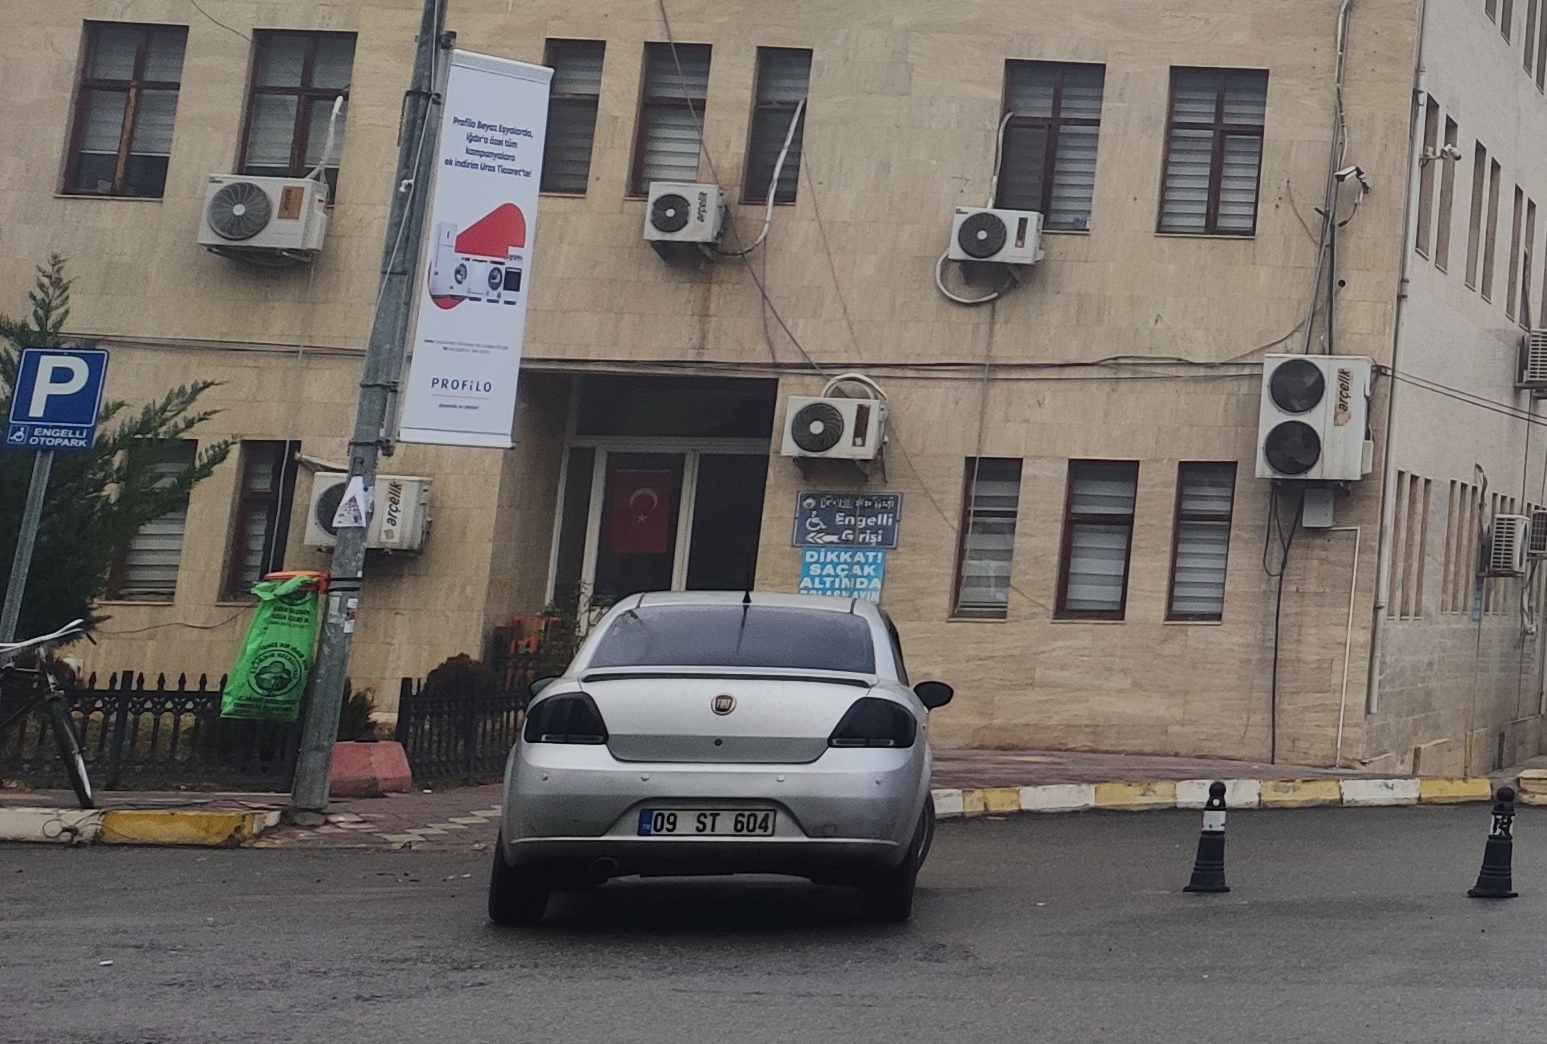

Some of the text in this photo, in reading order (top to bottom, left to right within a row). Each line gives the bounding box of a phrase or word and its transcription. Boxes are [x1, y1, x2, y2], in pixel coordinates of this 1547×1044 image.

[452, 116, 476, 128] Profilo
[477, 120, 498, 132] Beyaz
[444, 158, 453, 166] ek
[455, 157, 479, 170] indirim
[28, 355, 90, 418] P
[1337, 368, 1352, 412] arçelik
[33, 427, 88, 438] ENGELLİ
[29, 436, 88, 447] OTOPARK
[386, 478, 404, 527] arçelik
[835, 512, 894, 528] Engelli
[841, 529, 884, 546] Grişi
[805, 548, 883, 563] DİKKAT!
[809, 563, 877, 578] SAÇAK
[799, 576, 881, 589] ALTINDA
[653, 812, 678, 833] 09
[695, 812, 720, 833] ST
[733, 812, 770, 833] 604
